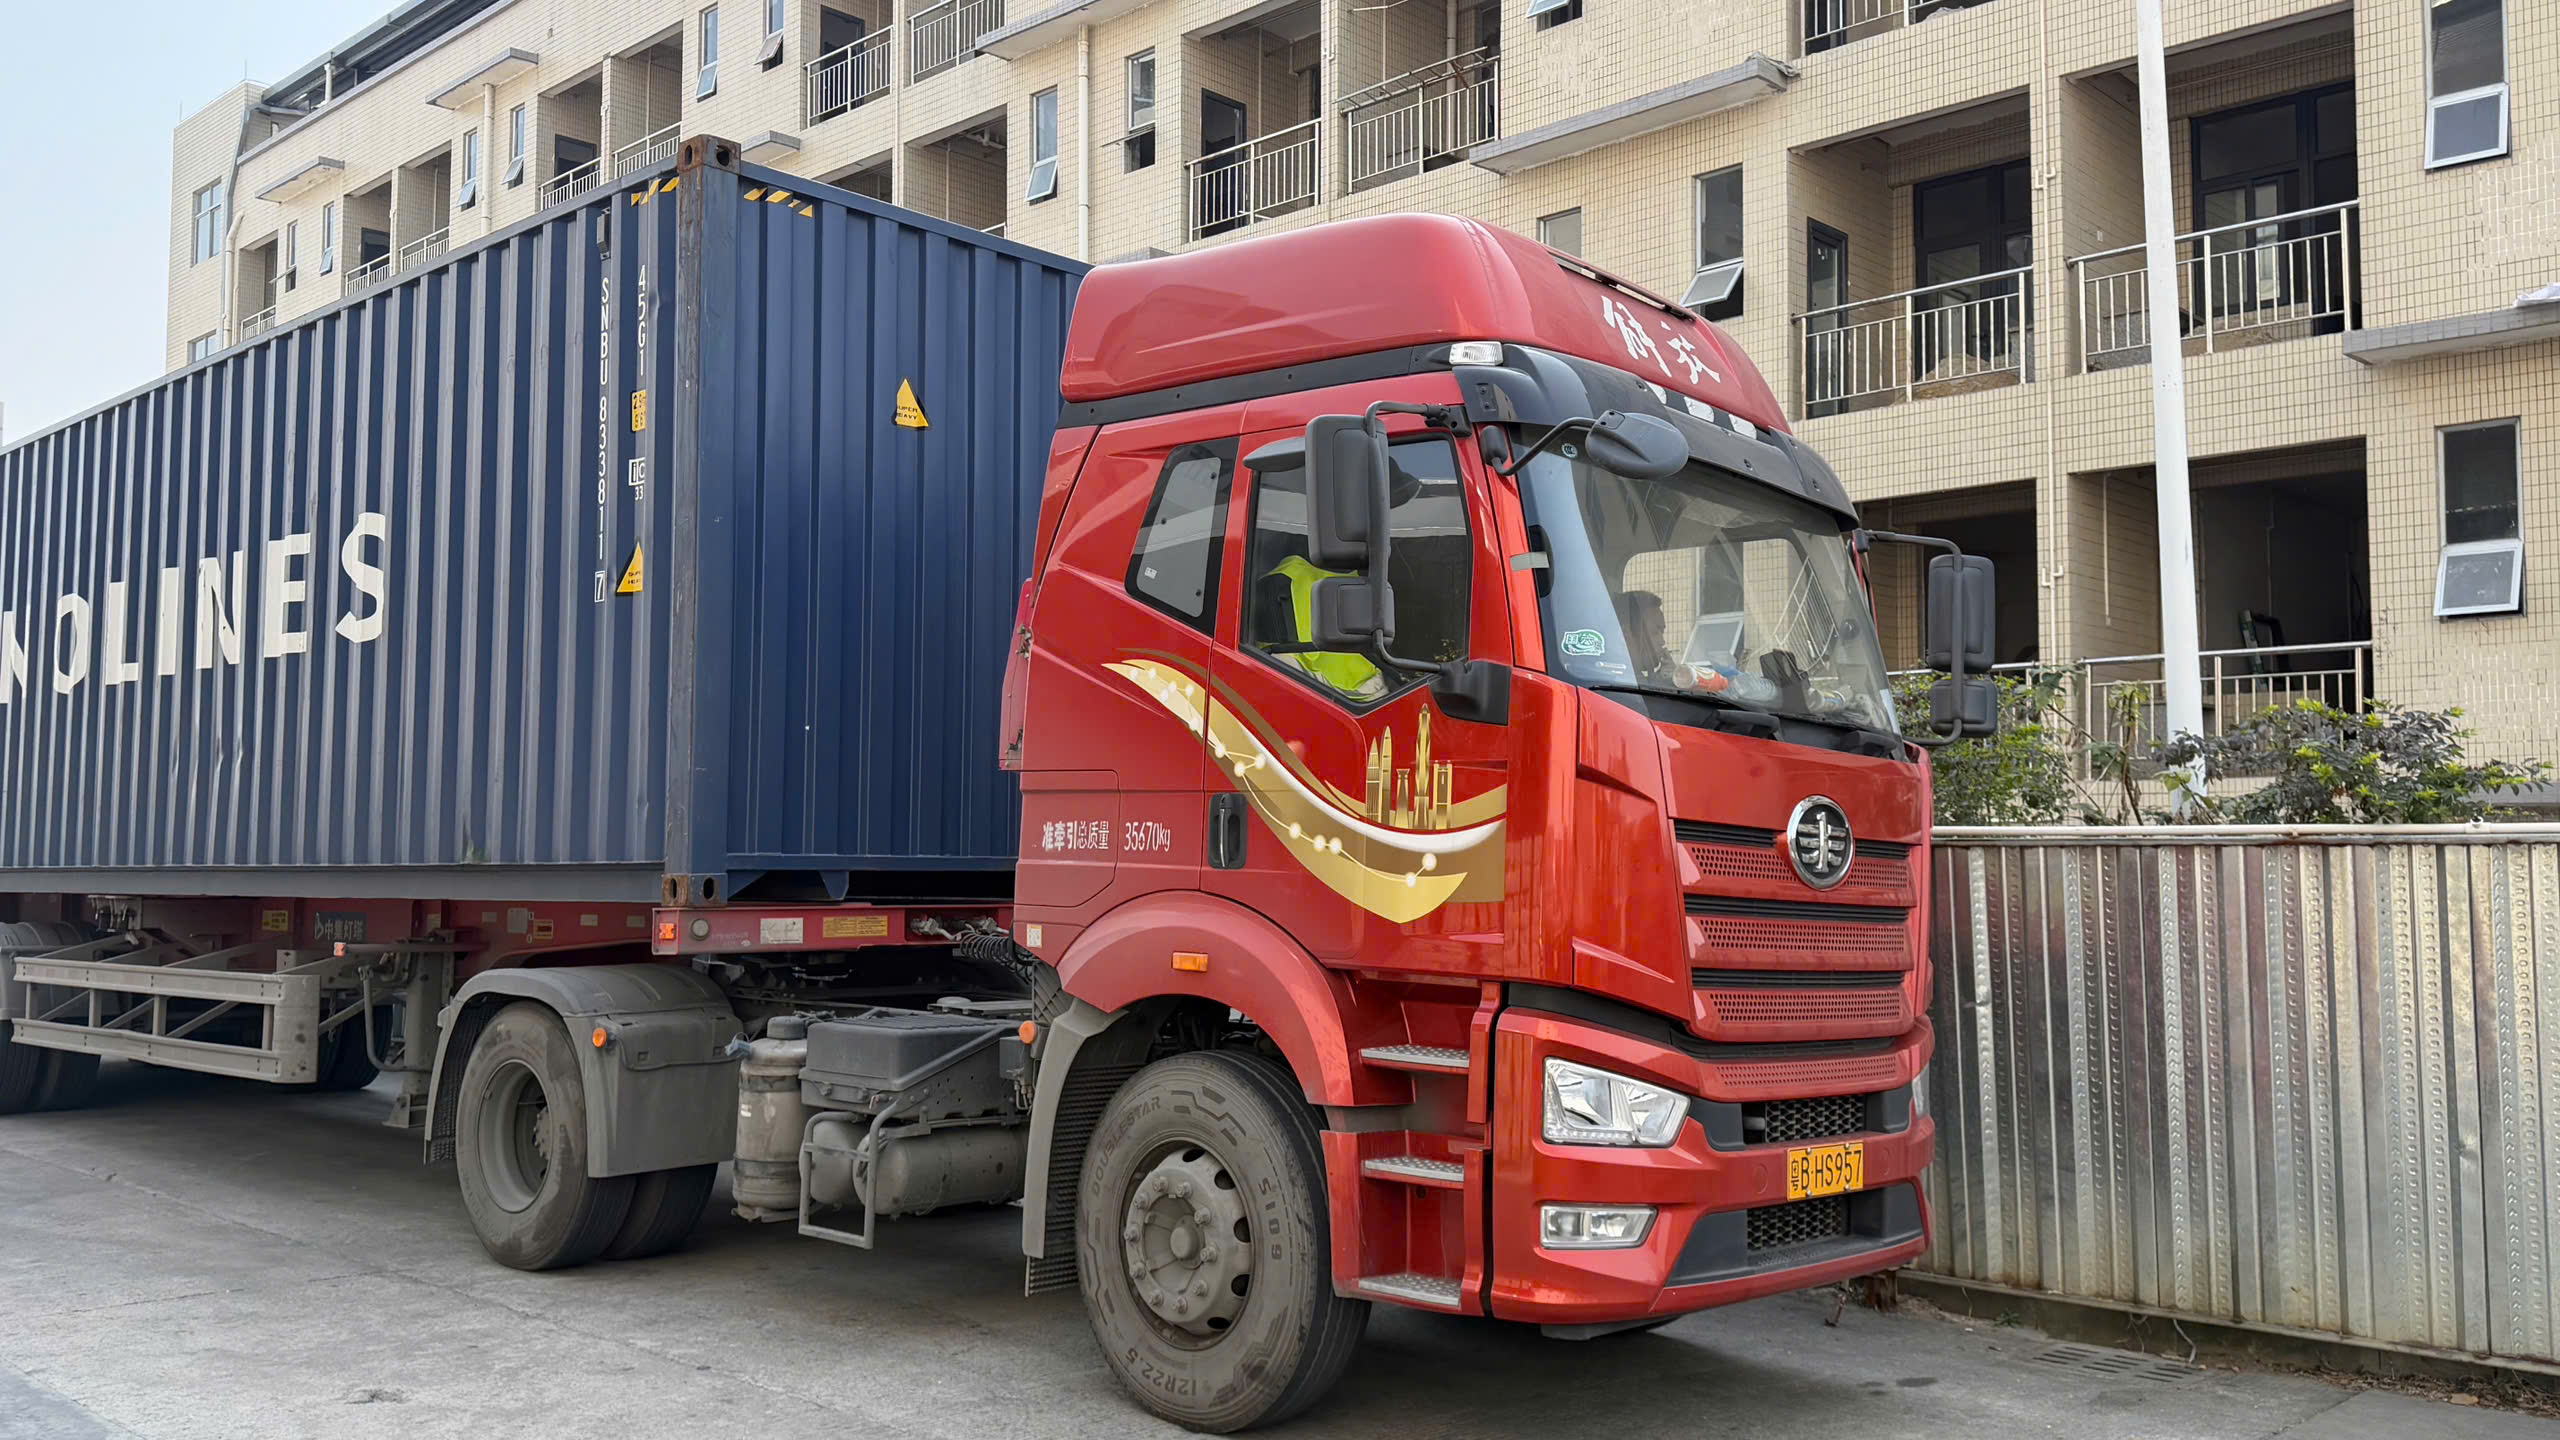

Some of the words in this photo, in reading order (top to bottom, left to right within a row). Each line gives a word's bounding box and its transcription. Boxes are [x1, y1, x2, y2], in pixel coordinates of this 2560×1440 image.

[600, 277, 609, 386] SNBU
[637, 264, 647, 376] 45G1
[598, 396, 608, 560] 833811
[0, 512, 386, 702] NOLINES
[595, 572, 604, 601] 7
[1042, 820, 1110, 852] 准牵引总质量
[1124, 821, 1171, 852] 35670kg
[1125, 1348, 1197, 1397] 12R22.5
